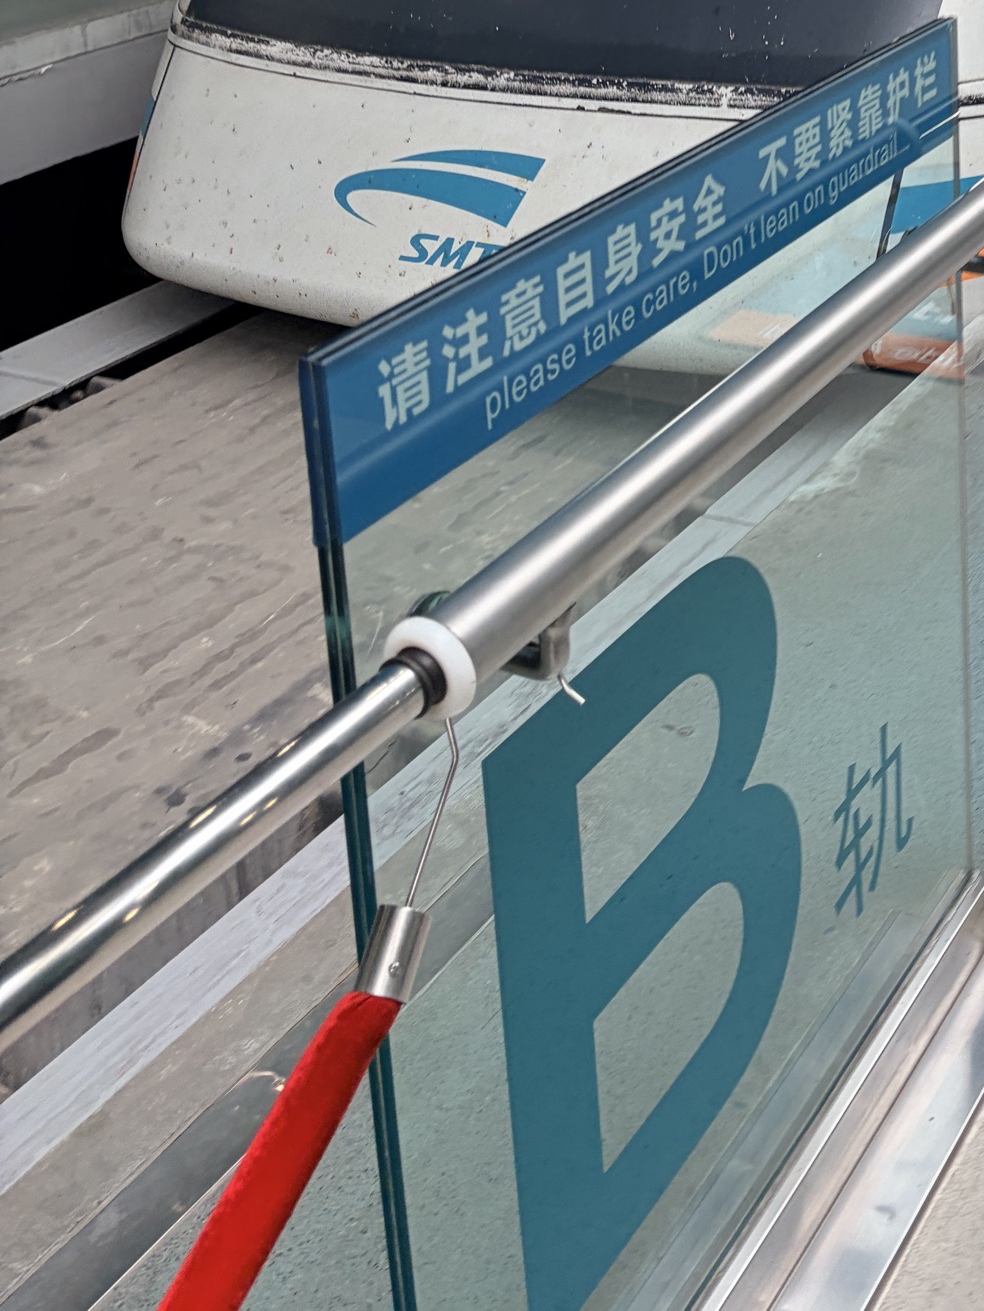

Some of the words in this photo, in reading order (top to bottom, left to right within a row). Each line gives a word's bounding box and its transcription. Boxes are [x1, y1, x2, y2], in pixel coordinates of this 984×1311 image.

[378, 173, 727, 431] 请注意自身安全
[758, 50, 938, 198] 不要紧靠护栏
[399, 233, 506, 269] SMT
[485, 344, 577, 430] please
[583, 304, 636, 356] take
[642, 271, 698, 319] care,
[704, 217, 757, 278] Don't
[760, 200, 799, 244] lean
[804, 185, 825, 213] on
[829, 135, 899, 205] guardrail
[482, 556, 801, 1311] B
[834, 721, 914, 918] 轨
